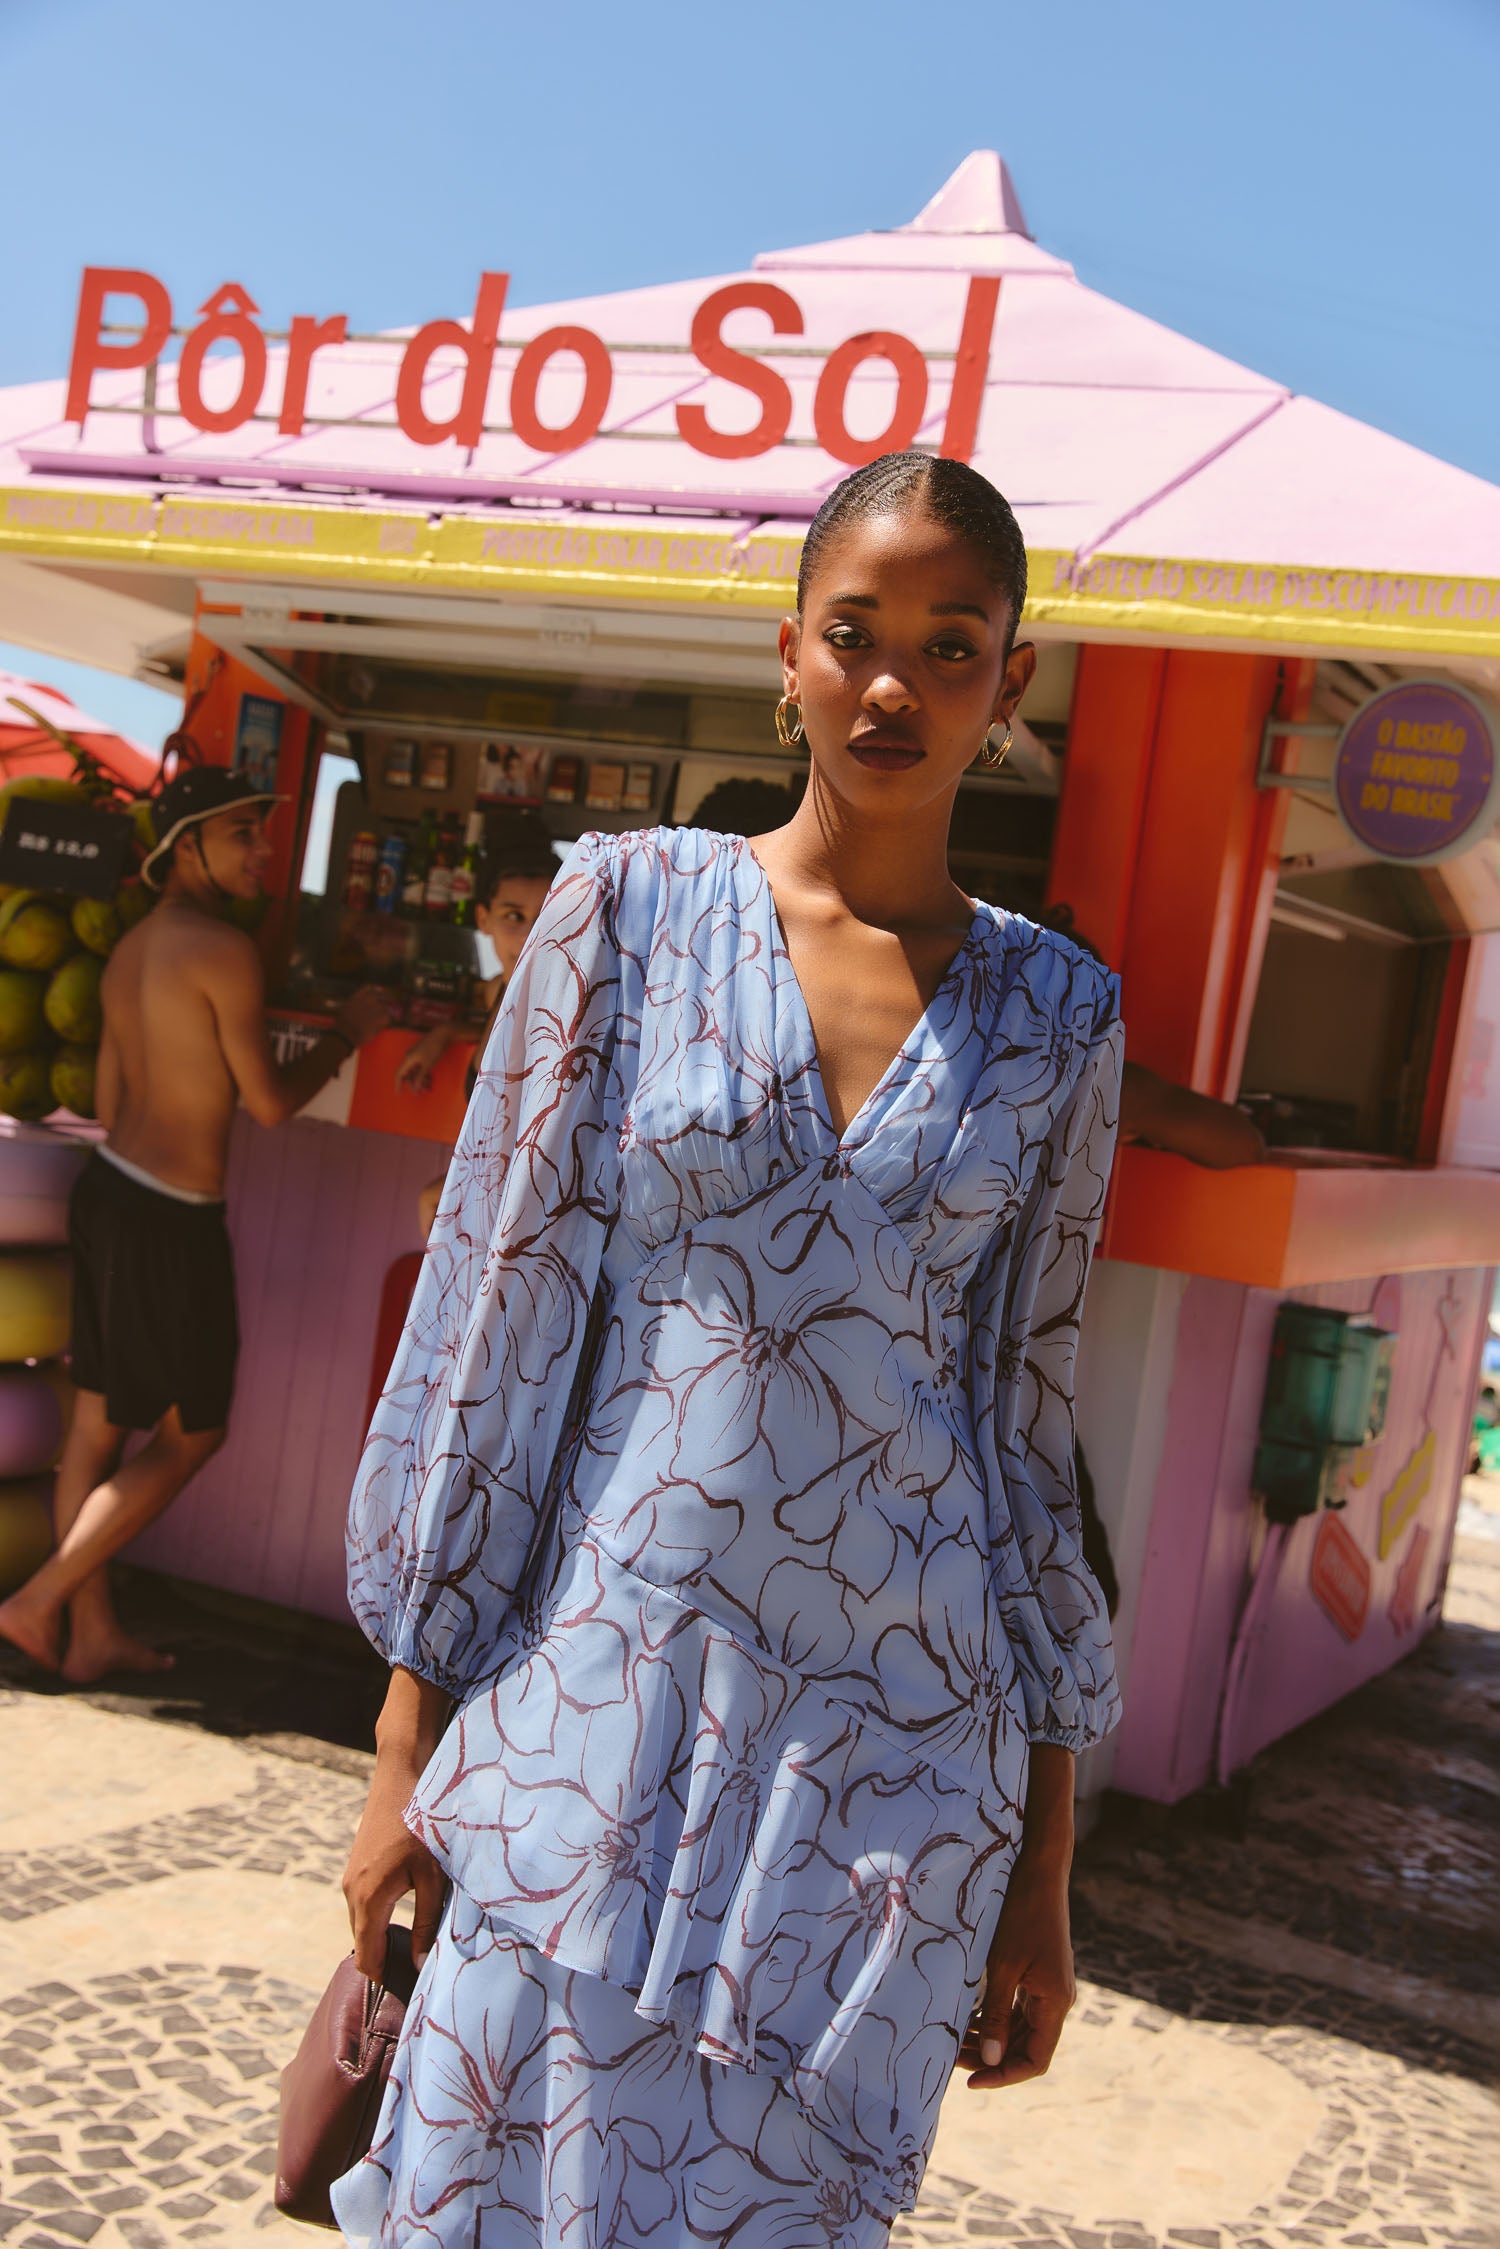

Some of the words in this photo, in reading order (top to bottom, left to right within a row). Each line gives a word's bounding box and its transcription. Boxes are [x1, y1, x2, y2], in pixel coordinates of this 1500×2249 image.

[64, 267, 347, 435] Pôr
[393, 272, 613, 455] do
[675, 275, 1002, 467] Sol
[481, 527, 590, 568] PROTEÇÃO
[593, 533, 668, 572] SOLAR
[667, 540, 801, 577] DESCOMPLIC
[1053, 556, 1186, 600] PROTEÇÃO
[1189, 566, 1276, 606] SOLAR
[1282, 572, 1500, 622] DESCOMPLICADA
[1378, 718, 1393, 746] O
